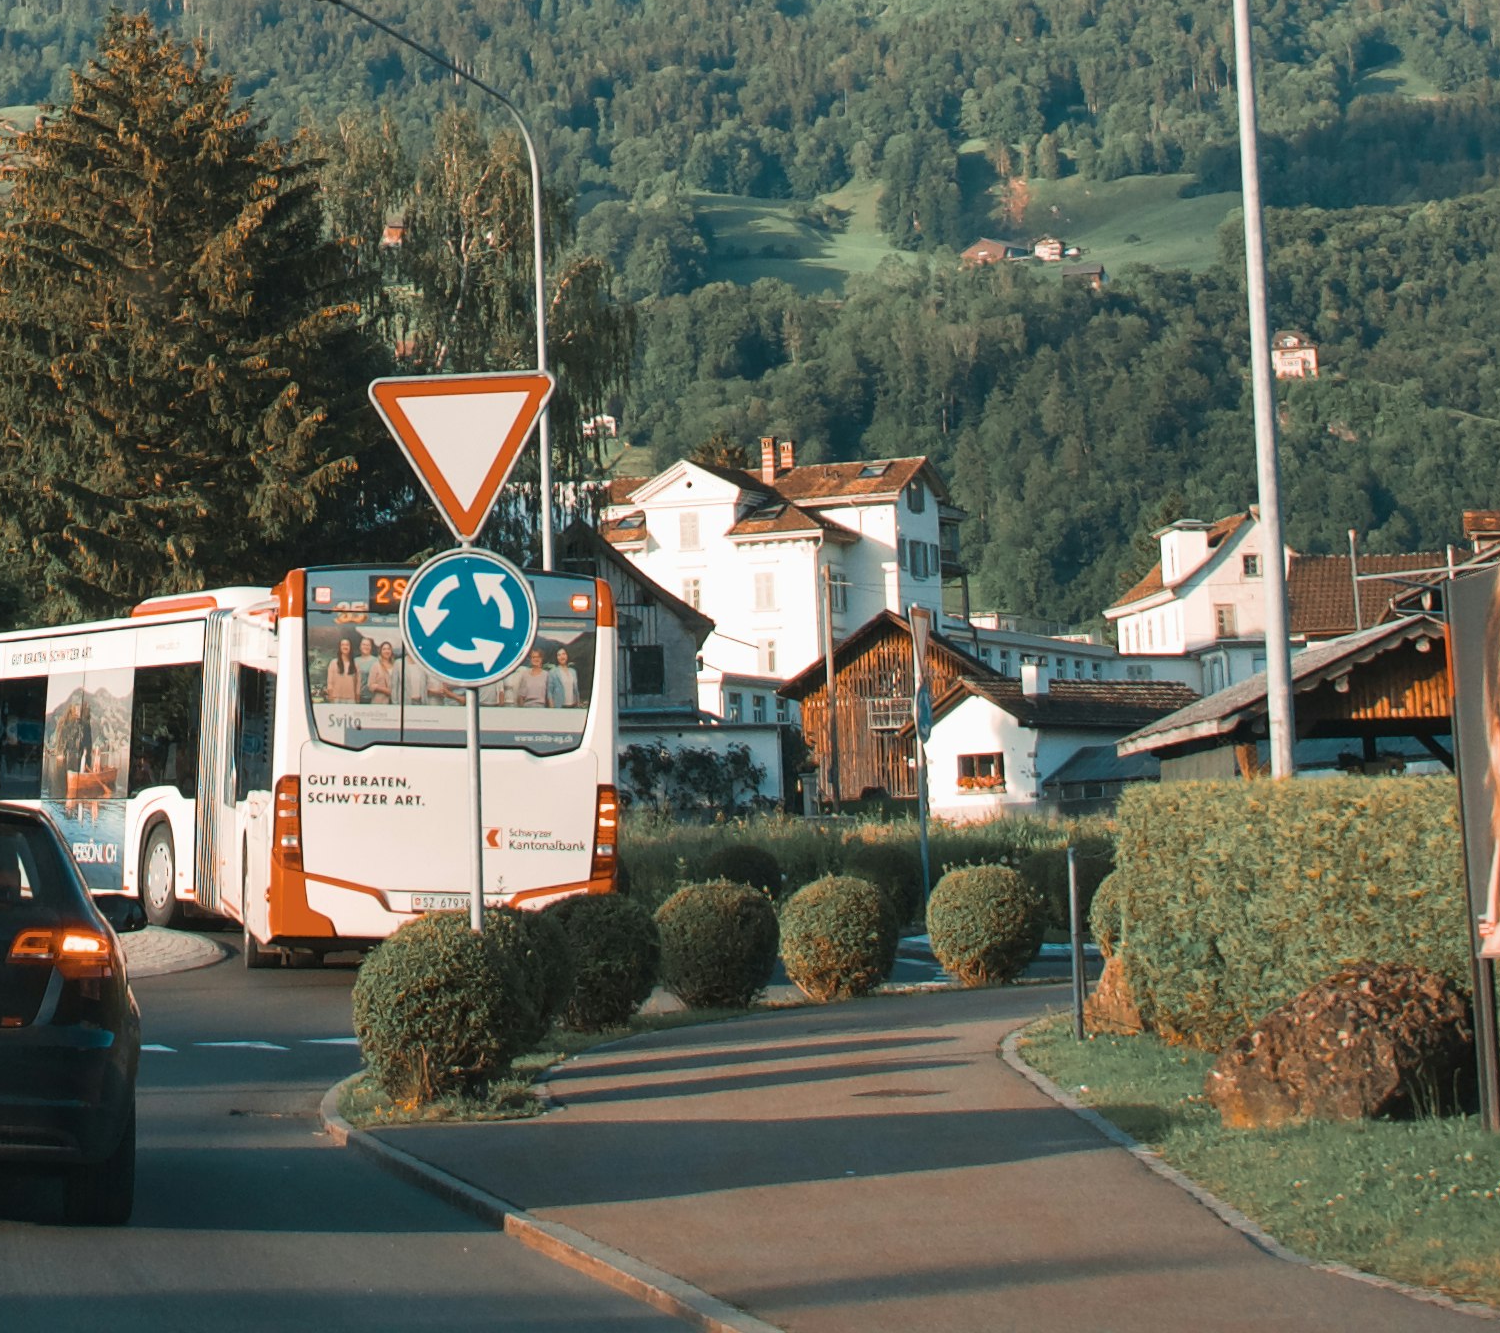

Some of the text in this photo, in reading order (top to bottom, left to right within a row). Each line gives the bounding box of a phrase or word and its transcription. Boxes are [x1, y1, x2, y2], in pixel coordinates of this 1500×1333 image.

[308, 774, 412, 790] GUT BERATEN,
[308, 792, 426, 807] SCHWYZER ART.
[509, 828, 552, 839] Schwyzer
[509, 840, 586, 852] Kantonalbank
